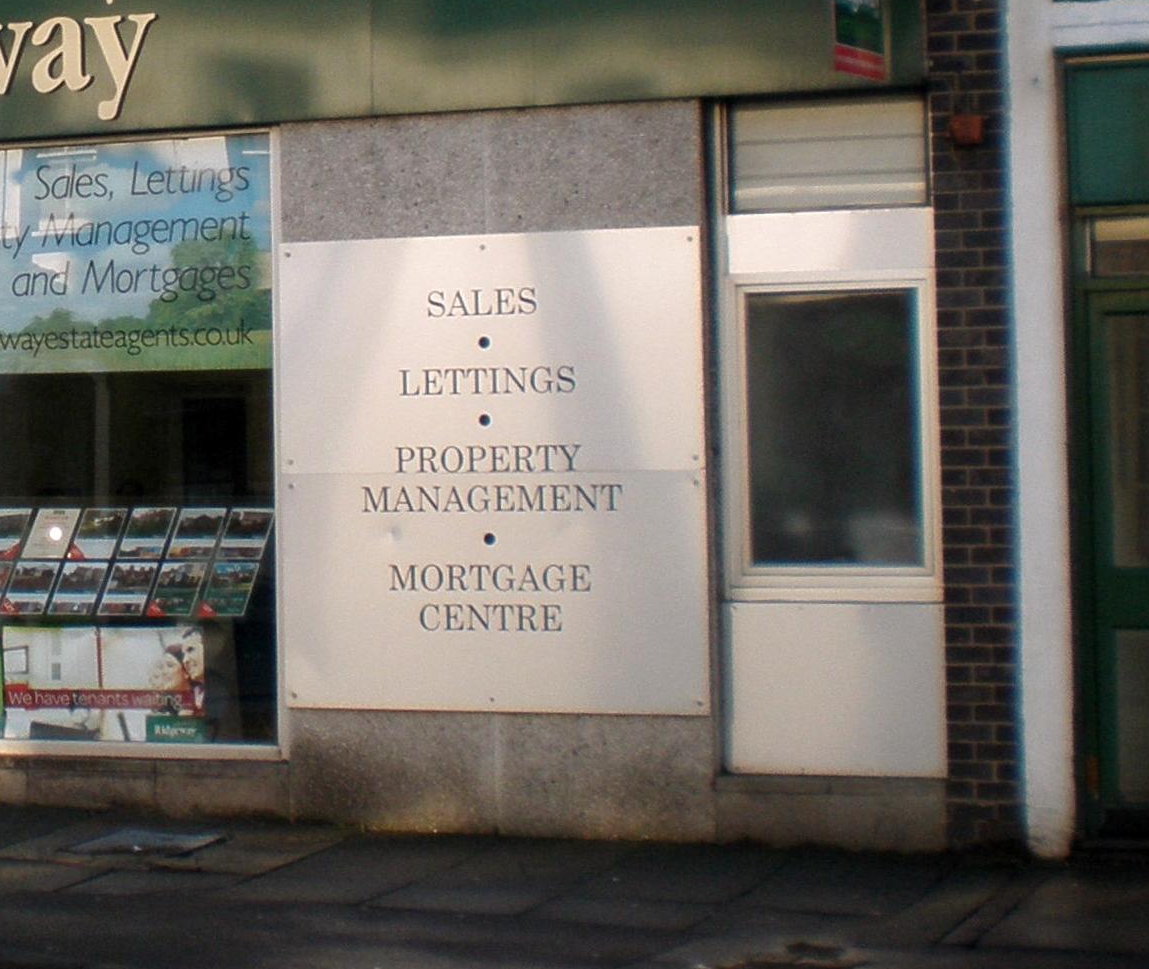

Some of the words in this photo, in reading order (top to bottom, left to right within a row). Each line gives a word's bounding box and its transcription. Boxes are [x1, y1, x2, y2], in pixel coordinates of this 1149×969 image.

[34, 164, 115, 201] Sales,
[131, 161, 251, 203] Lettings
[41, 211, 252, 254] Management
[11, 260, 69, 297] and
[81, 258, 252, 303] Mortgages
[426, 287, 538, 318] SALES
[399, 365, 577, 397] LETTINGS
[394, 444, 583, 474] PROPERTY
[361, 484, 624, 514] MANAGEMENT
[388, 564, 593, 593] MORTGAGE
[418, 603, 564, 633] CENTRE
[9, 691, 33, 706] We
[35, 691, 71, 706] have
[72, 691, 130, 706] tenants
